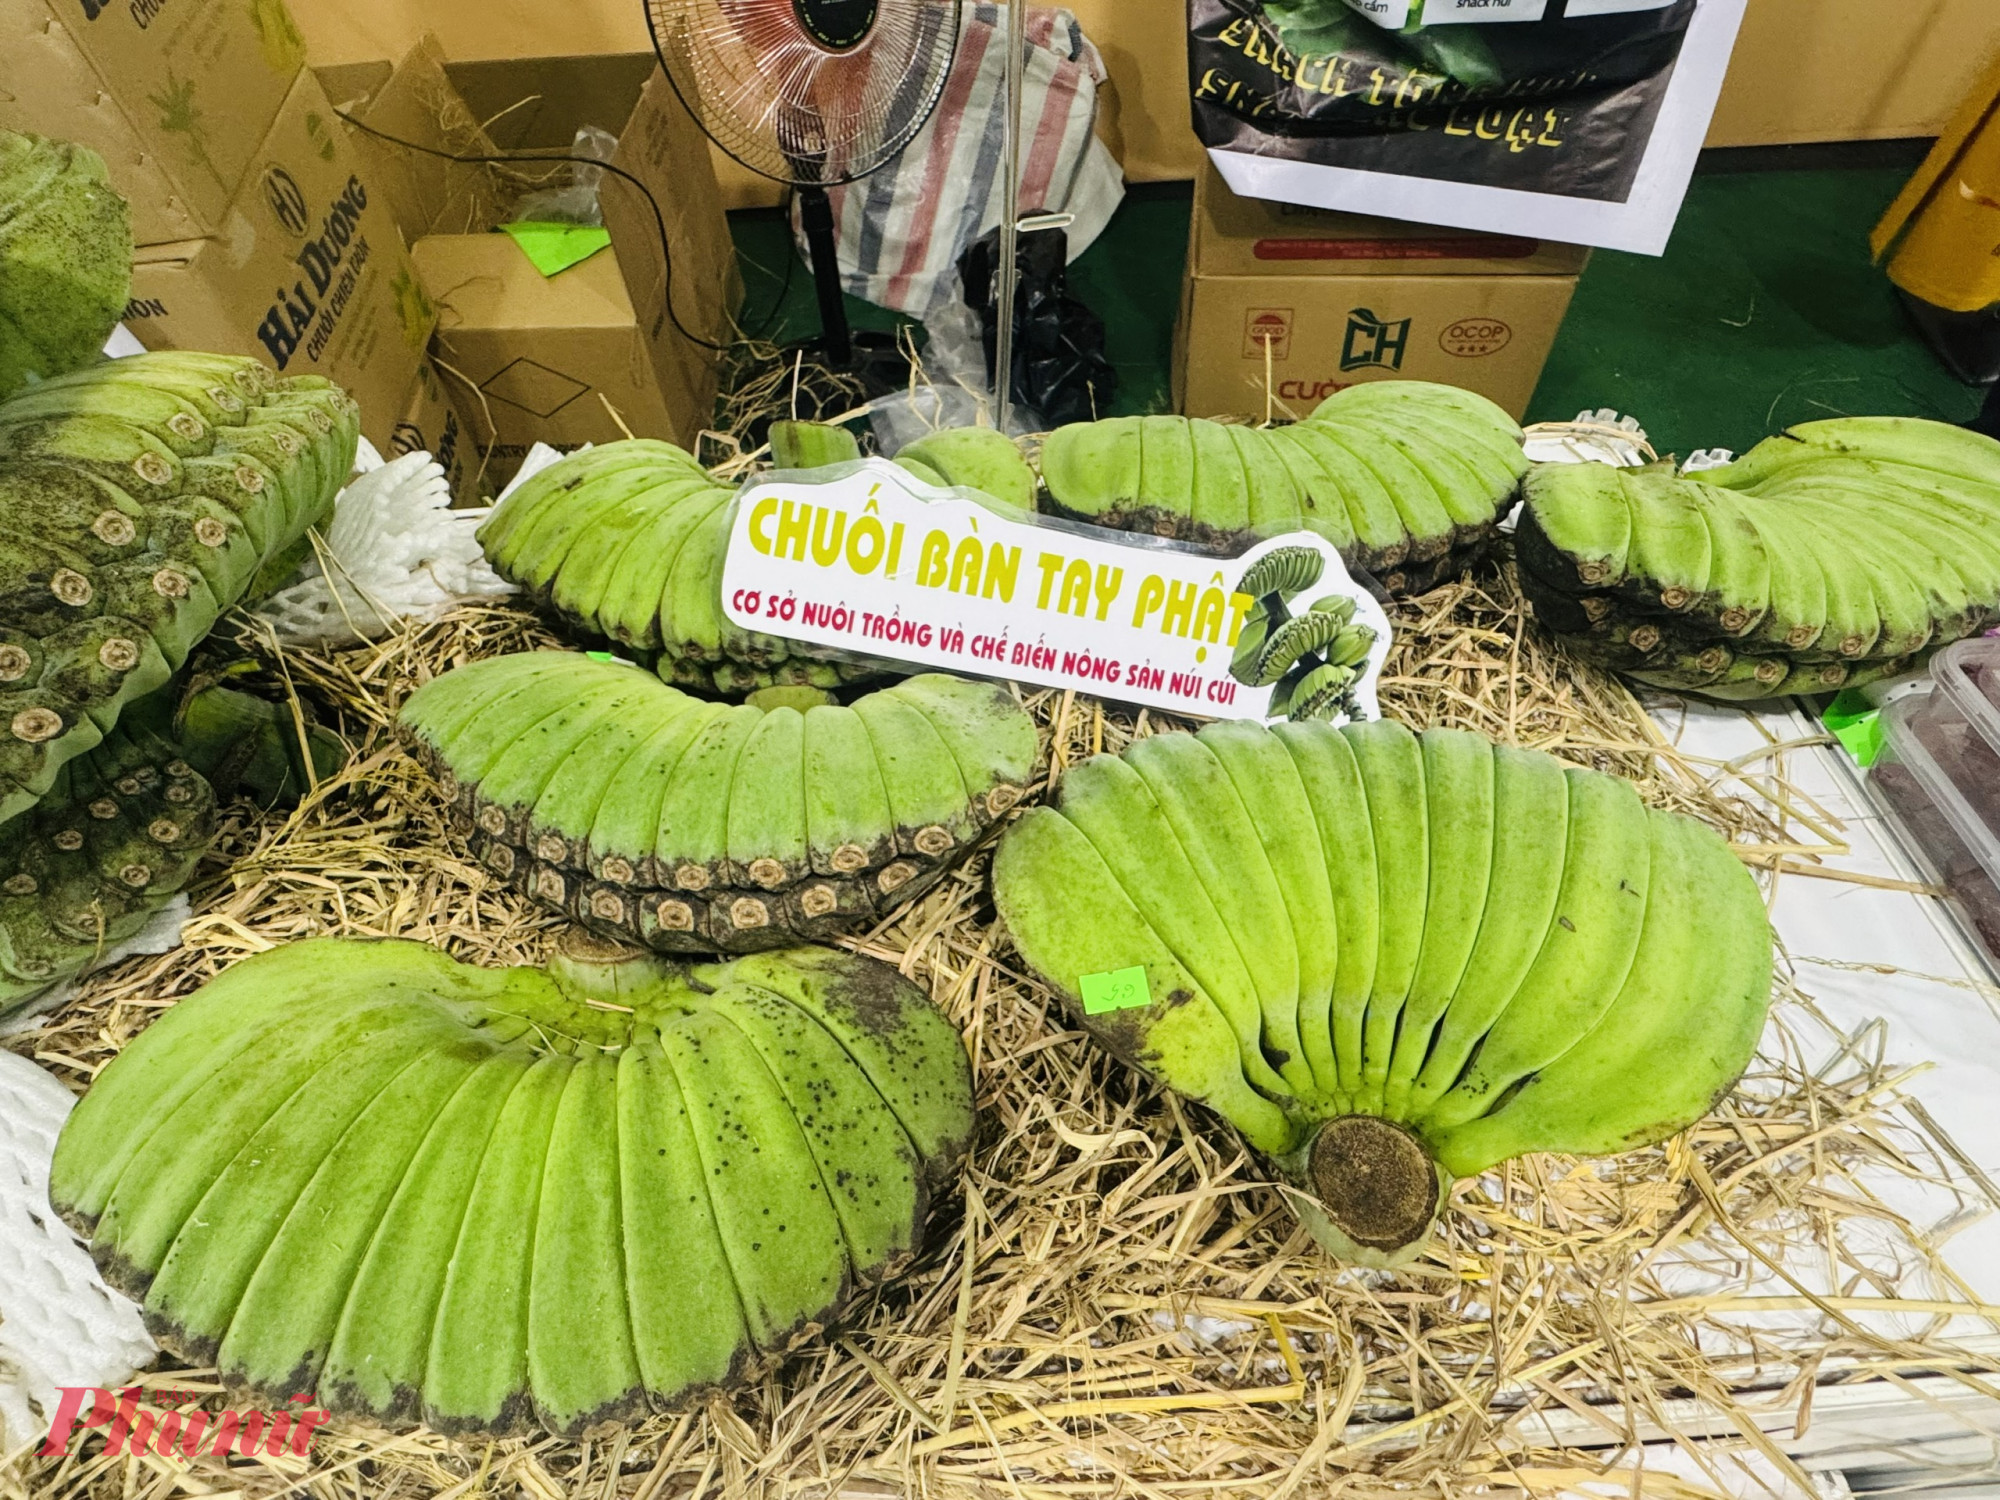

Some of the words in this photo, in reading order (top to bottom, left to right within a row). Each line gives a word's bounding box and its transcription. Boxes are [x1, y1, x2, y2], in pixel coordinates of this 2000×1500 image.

[257, 280, 317, 371] HẢI
[297, 174, 368, 299] DƯƠNG
[1450, 325, 1505, 339] OCOP
[732, 589, 762, 613] CƠ
[765, 589, 797, 621] SỞ
[801, 600, 855, 633] NUÔI
[862, 604, 932, 648] TRỒNG
[939, 622, 965, 655] VÀ
[970, 625, 1009, 662] CHẾ
[1011, 632, 1058, 672] BIẾN
[1061, 647, 1122, 684] NÔNG
[1125, 658, 1166, 692] SẢN
[1168, 667, 1204, 699] NÚI
[1206, 673, 1237, 706] CÚI
[749, 483, 905, 580] CHUỐI
[916, 516, 1022, 603] BÀN
[1036, 552, 1124, 622] TAY
[1131, 571, 1254, 664] PHẬT
